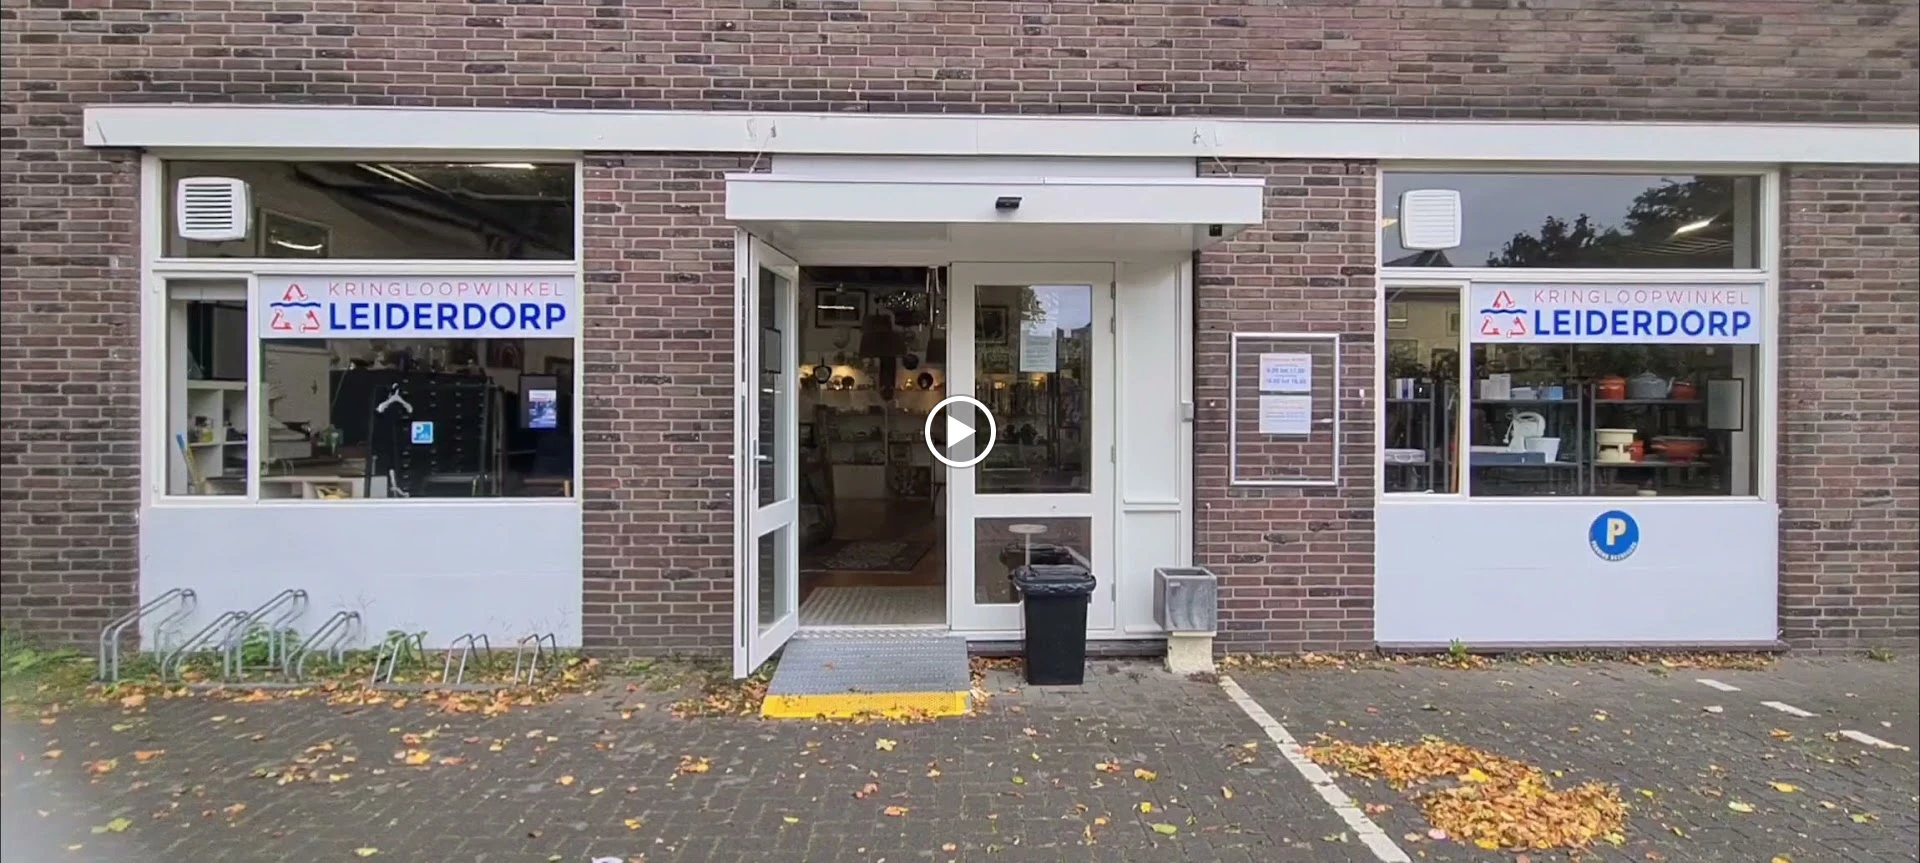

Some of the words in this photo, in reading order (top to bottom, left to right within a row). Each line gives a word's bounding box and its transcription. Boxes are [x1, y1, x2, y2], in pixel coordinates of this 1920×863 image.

[328, 282, 564, 297] KRINGLOOPWINKEL
[1534, 289, 1749, 304] KRINGLOOPWINKEL
[329, 302, 566, 330] LEIDERDORP
[1534, 309, 1751, 336] LEIDERDORP
[1606, 517, 1627, 546] P
